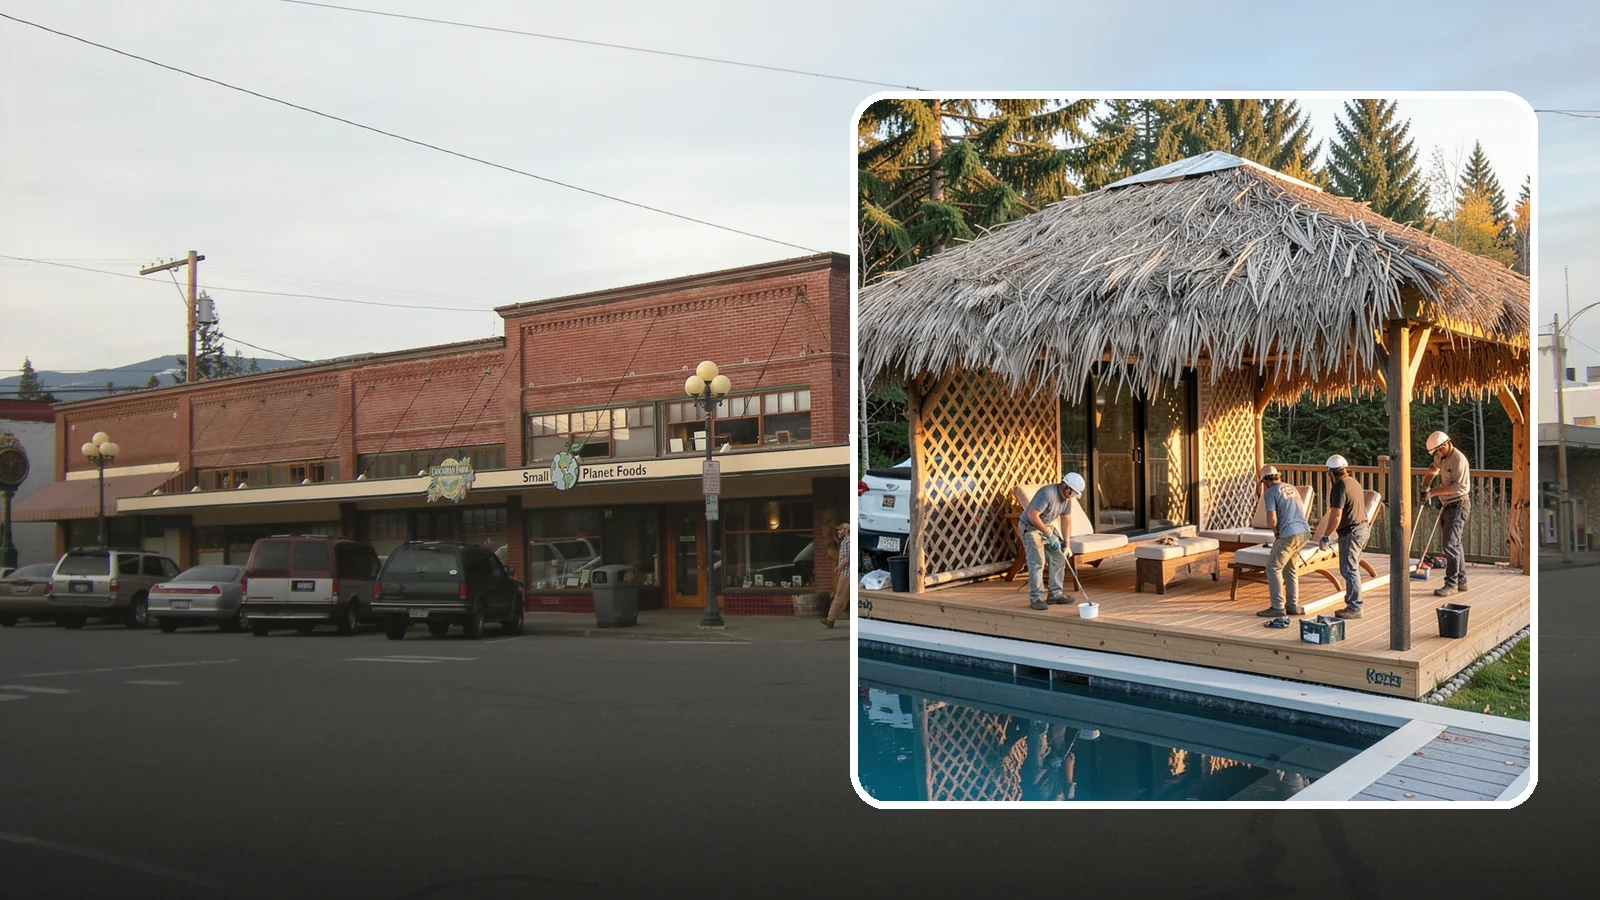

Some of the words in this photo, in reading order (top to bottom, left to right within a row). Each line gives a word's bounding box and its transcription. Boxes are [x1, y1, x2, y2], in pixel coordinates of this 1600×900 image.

[431, 467, 456, 476] CASCADIAN
[523, 470, 549, 482] Small
[583, 467, 614, 479] Planet
[617, 464, 647, 477] Foods
